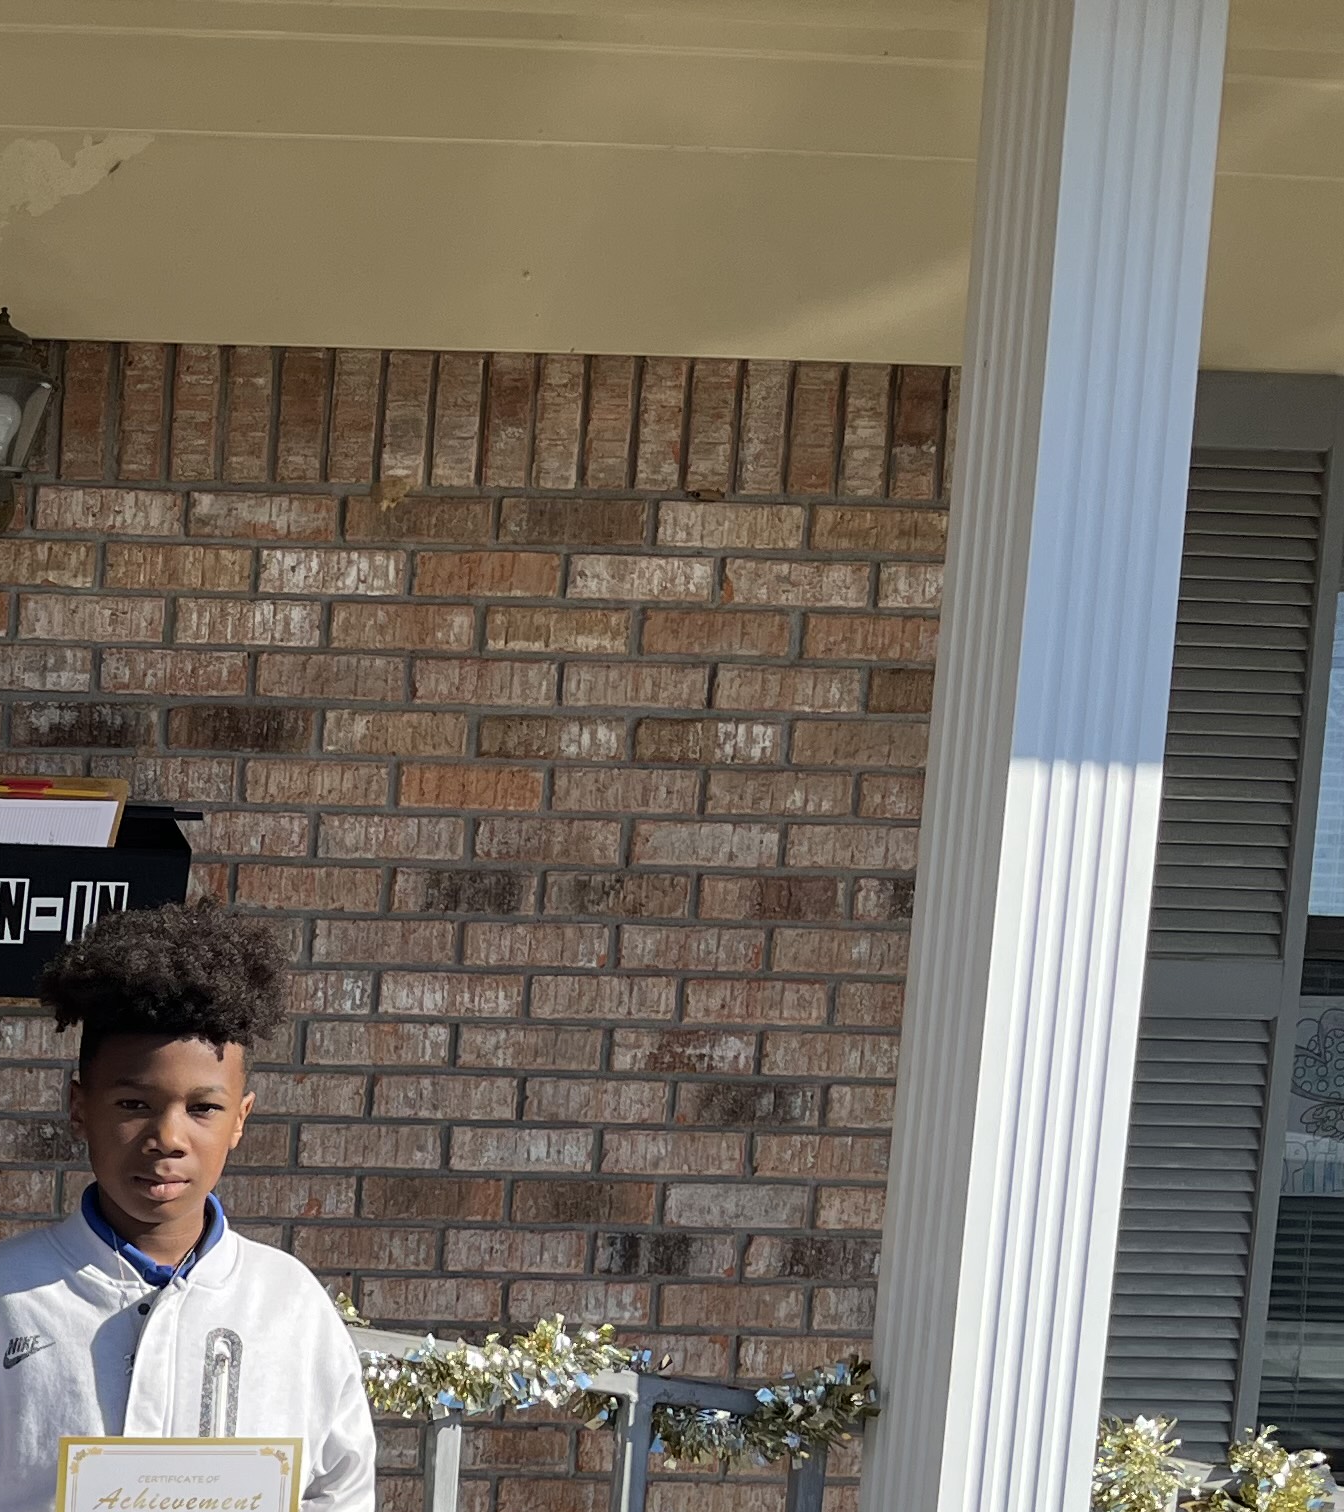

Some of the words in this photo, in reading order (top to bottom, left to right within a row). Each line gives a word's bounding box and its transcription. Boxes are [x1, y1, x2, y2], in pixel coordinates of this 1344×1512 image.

[8, 1335, 40, 1355] NIKE
[137, 1475, 204, 1484] CERTIFICATE
[206, 1475, 220, 1484] OF
[92, 1487, 263, 1511] Achievement
